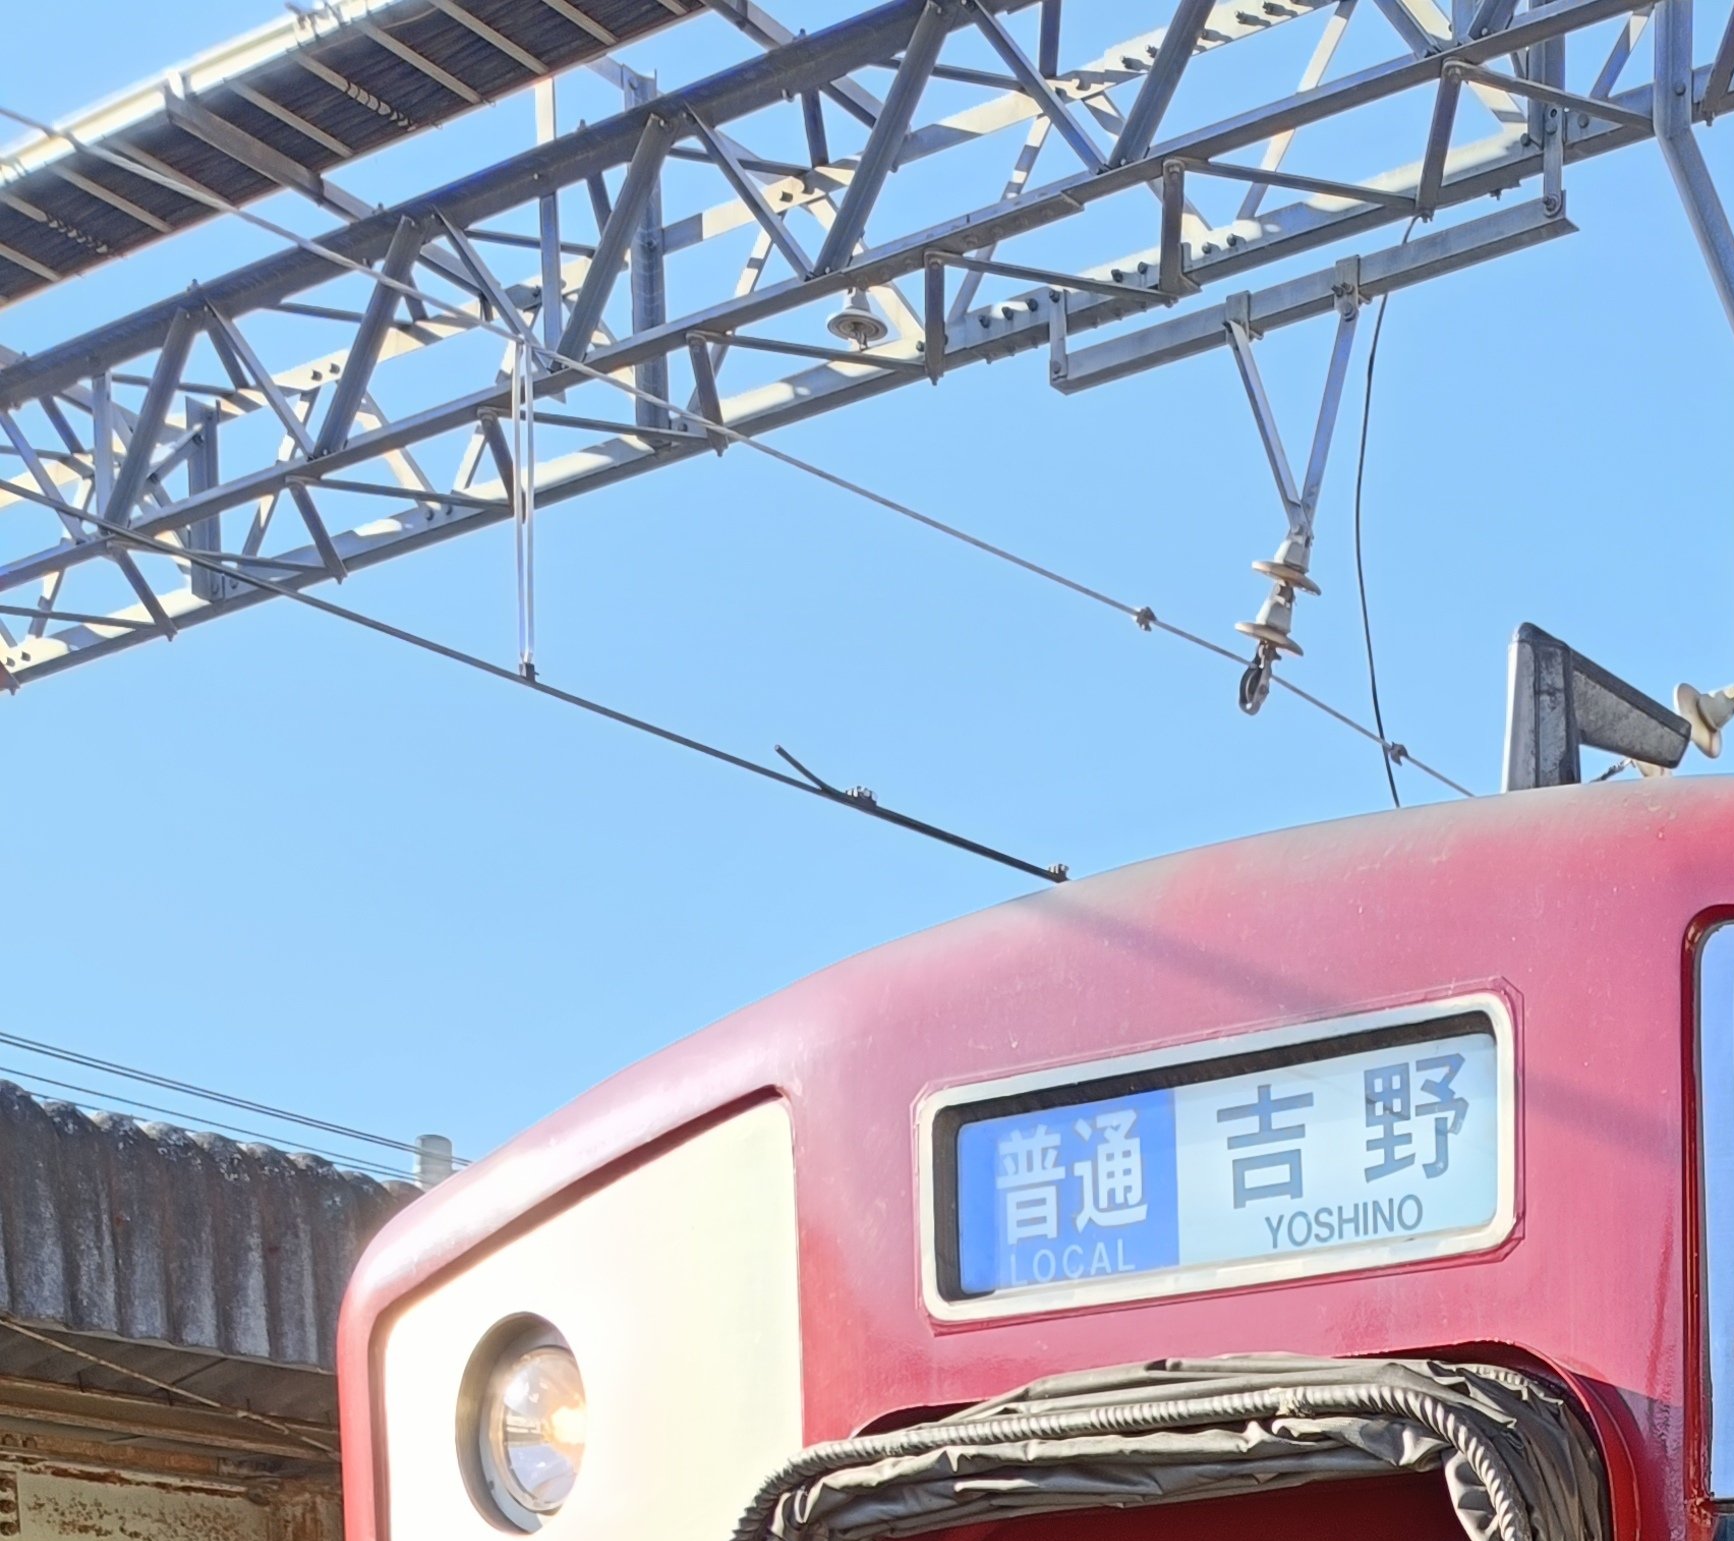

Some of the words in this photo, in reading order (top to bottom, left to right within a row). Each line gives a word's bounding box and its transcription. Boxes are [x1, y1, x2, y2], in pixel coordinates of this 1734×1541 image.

[996, 1108, 1150, 1246] 普通
[1216, 1052, 1471, 1209] 吉野
[1011, 1239, 1136, 1286] LOCAL
[1265, 1194, 1424, 1250] YOSHINO
